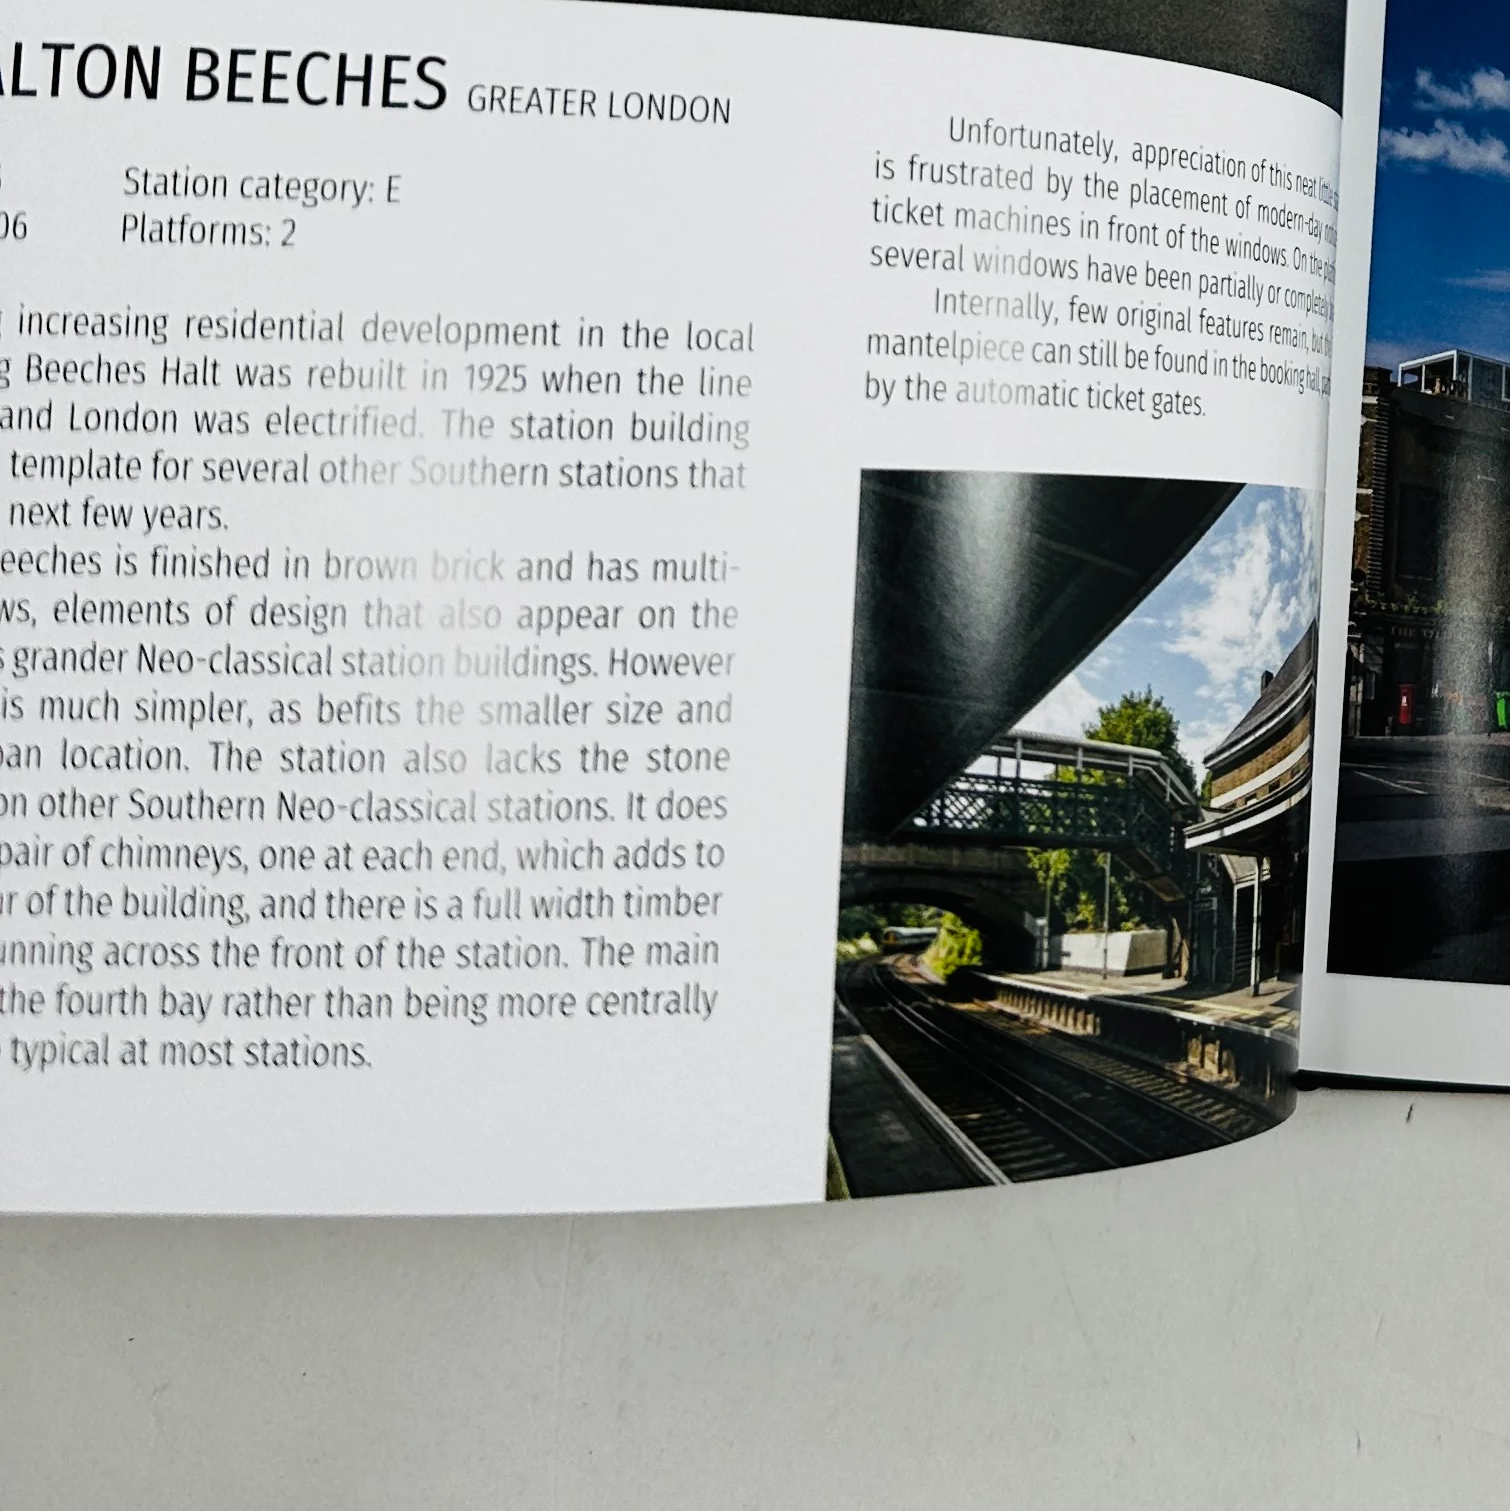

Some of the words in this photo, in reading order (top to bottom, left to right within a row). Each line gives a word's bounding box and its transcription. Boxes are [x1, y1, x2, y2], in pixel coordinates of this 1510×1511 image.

[0, 41, 161, 100] LTON
[185, 46, 447, 111] BEECHES
[467, 84, 597, 117] GREATER
[608, 91, 731, 125] LONDON
[949, 117, 1118, 164] Unfortunately,
[1132, 141, 1246, 178] appreciation
[1251, 157, 1267, 183] of
[1269, 163, 1293, 192] this
[1295, 174, 1317, 197] neat
[124, 166, 227, 198] Station
[240, 173, 374, 208] category:
[387, 174, 401, 204] E
[875, 150, 895, 181] is
[908, 153, 1033, 192] frustrated
[1047, 167, 1073, 202] by
[1083, 171, 1119, 201] the
[1130, 178, 1228, 217] placement
[1235, 193, 1252, 220] of
[1257, 203, 1323, 243] modern-day
[122, 213, 271, 246] Platforms:
[281, 218, 296, 248] 2
[18, 304, 168, 345] increasing
[185, 310, 343, 342] residential
[362, 313, 561, 351] development
[578, 316, 604, 348] in
[622, 318, 669, 350] the
[687, 321, 754, 353] local
[867, 330, 1025, 365] mantelpiece
[1031, 341, 1071, 365] can
[1078, 340, 1118, 368] still
[1125, 342, 1149, 371] be
[1154, 343, 1208, 376] found
[1213, 356, 1228, 378] in
[1232, 355, 1257, 382] the
[1260, 358, 1305, 395] booking
[865, 371, 896, 407] by
[904, 374, 947, 403] the
[956, 379, 1079, 409] automatic
[1086, 383, 1146, 413] ticket
[1152, 391, 1206, 421] gates.
[9, 498, 69, 527] next
[82, 496, 133, 529] few
[143, 505, 228, 536] years.
[11, 643, 124, 678] grander
[137, 643, 332, 676] Neo-classical
[342, 644, 445, 677] station
[455, 644, 598, 685] buildings.
[609, 648, 736, 677] However
[55, 983, 147, 1016] fourth
[160, 985, 212, 1020] bay
[224, 986, 312, 1016] rather
[325, 987, 393, 1017] than
[405, 985, 488, 1027] being
[498, 992, 577, 1018] more
[587, 982, 718, 1019] centrally
[10, 1034, 109, 1072] typical
[120, 1037, 148, 1067] at
[161, 1039, 233, 1067] most
[245, 1038, 372, 1067] stations.
